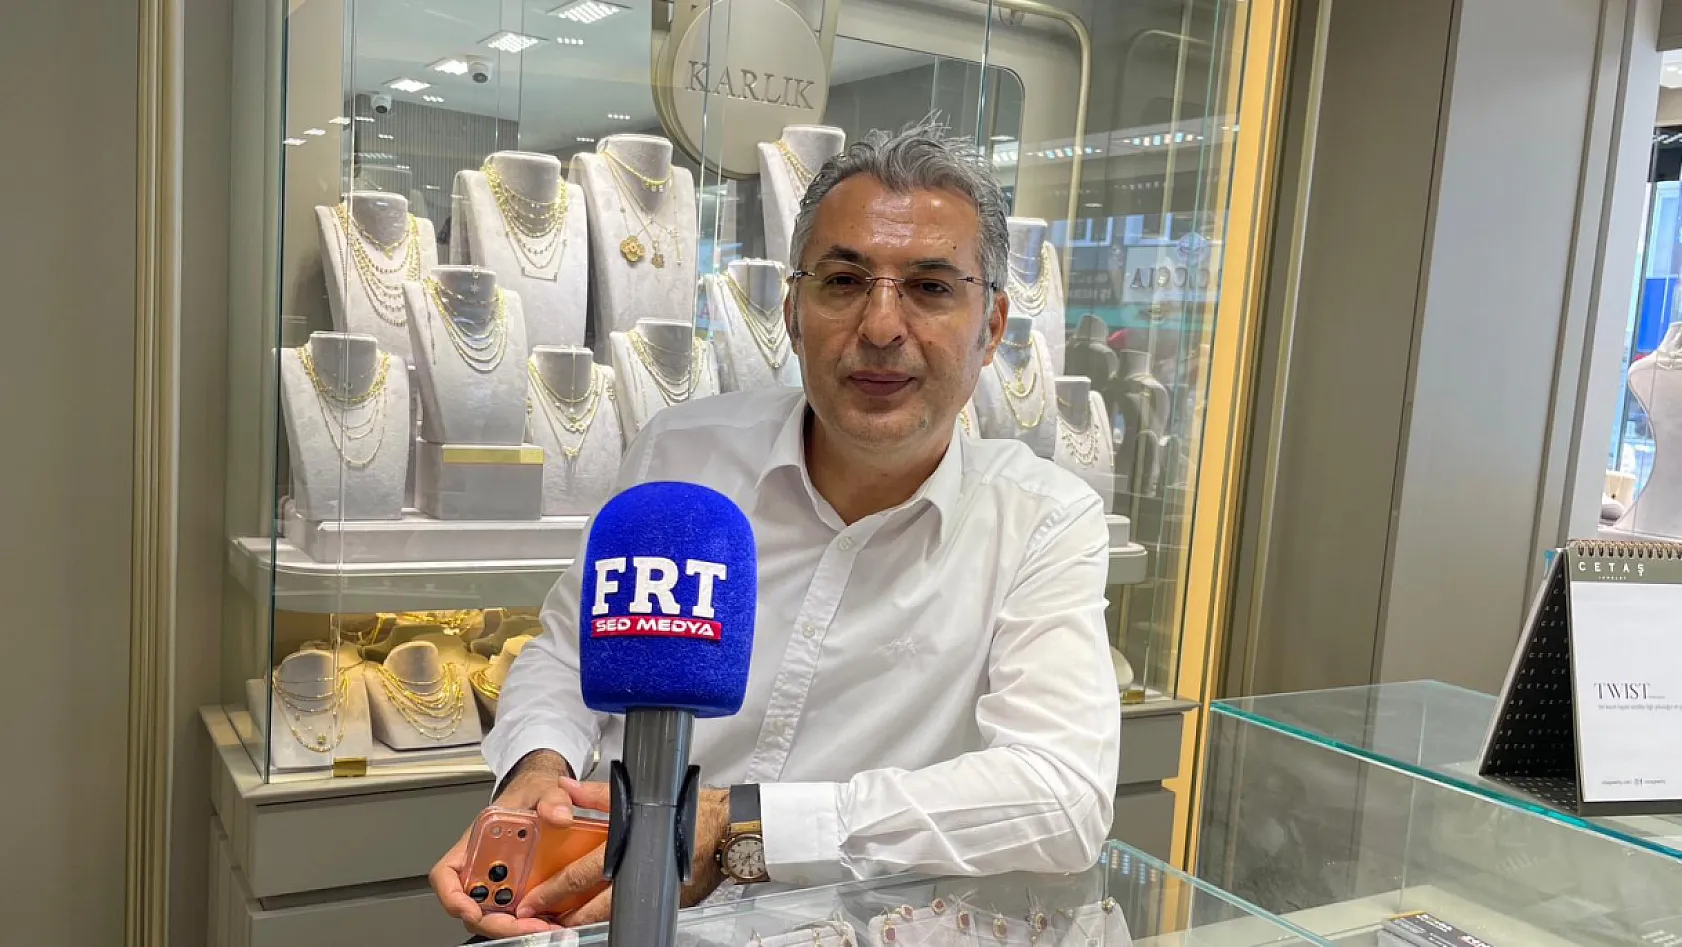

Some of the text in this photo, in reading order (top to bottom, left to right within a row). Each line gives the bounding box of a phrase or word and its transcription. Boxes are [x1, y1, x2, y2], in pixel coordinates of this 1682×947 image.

[685, 60, 815, 109] KARLIK
[1578, 561, 1644, 577] CETAŞ
[592, 556, 727, 618] FRT
[596, 618, 714, 636] SED MEDYA
[1594, 682, 1650, 700] TWIST
